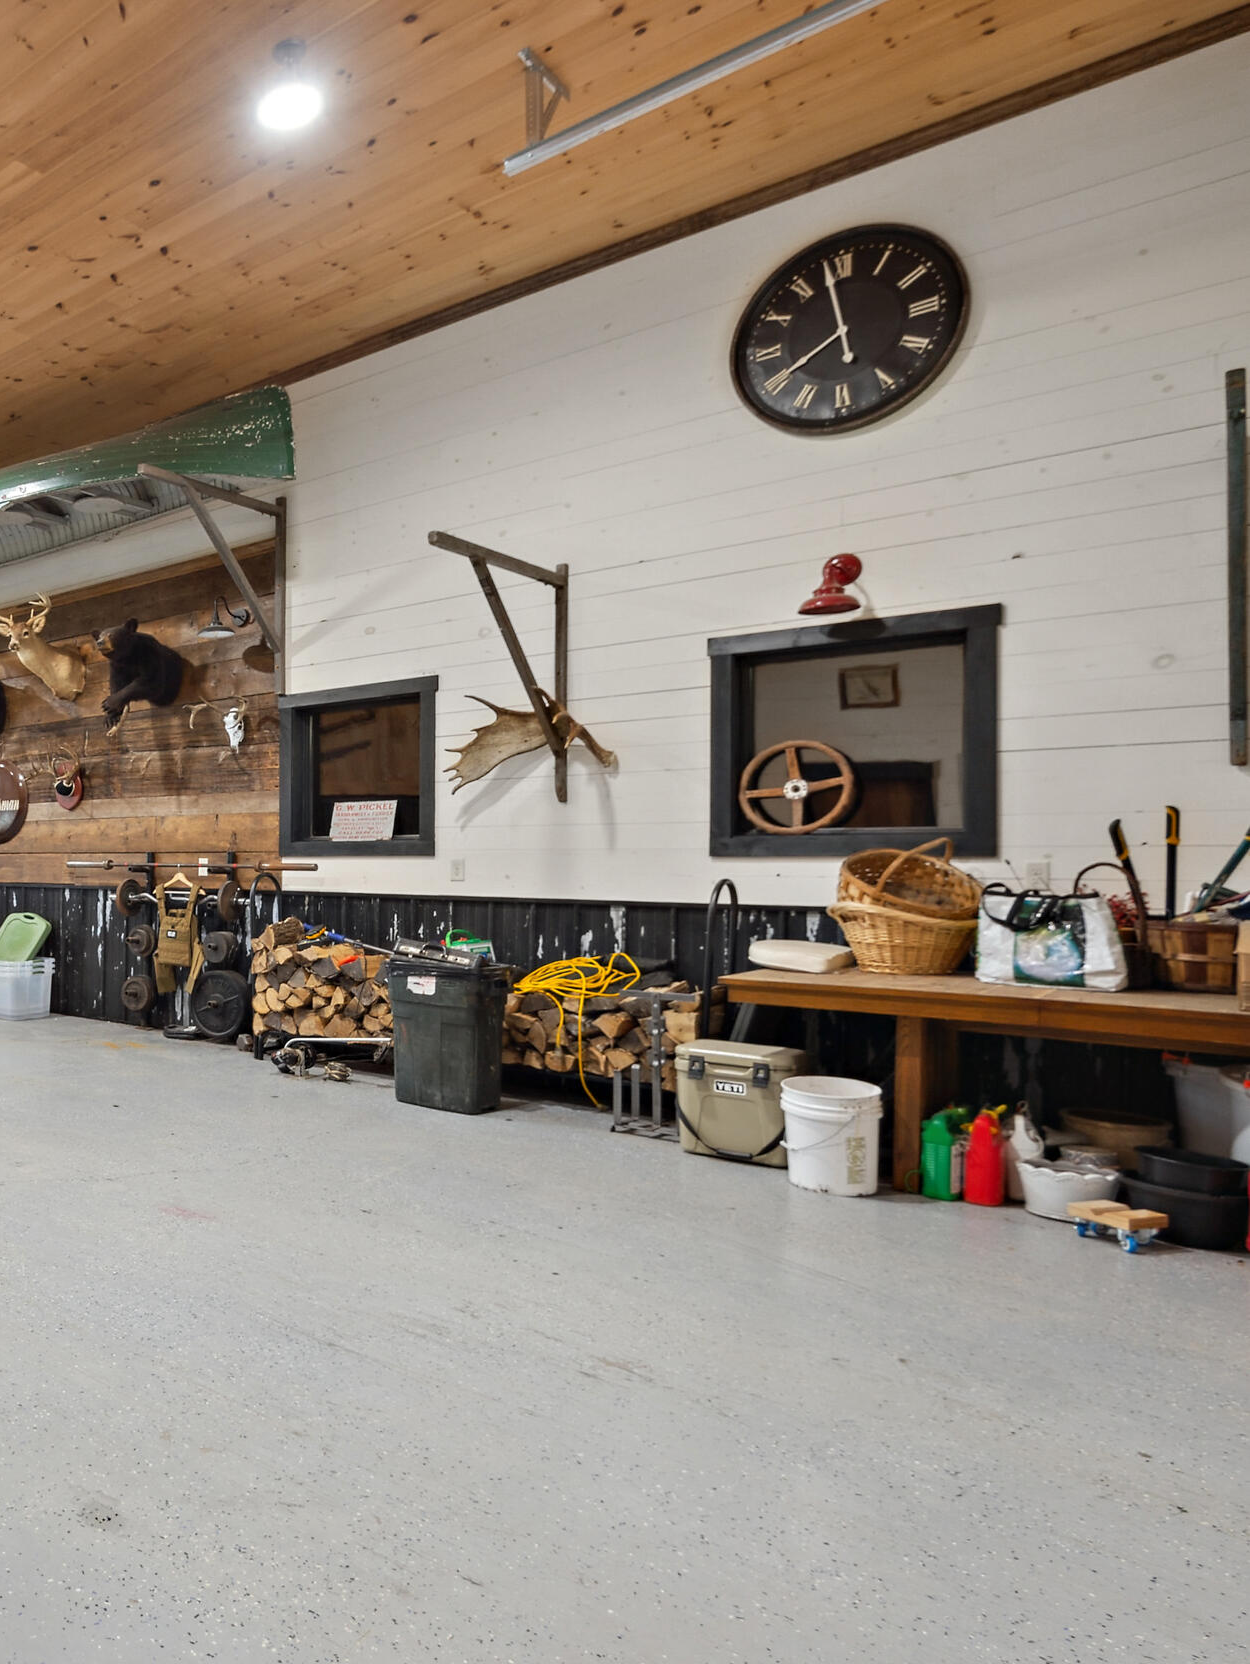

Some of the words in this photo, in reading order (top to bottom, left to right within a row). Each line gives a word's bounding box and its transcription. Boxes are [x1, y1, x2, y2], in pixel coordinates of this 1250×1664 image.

[834, 253, 853, 280] XII
[872, 250, 892, 276] I
[897, 264, 927, 290] II
[790, 278, 815, 303] XI
[908, 295, 940, 318] III
[765, 310, 792, 327] X
[755, 344, 782, 362] IX
[874, 367, 895, 389] V
[793, 384, 818, 408] VII
[834, 383, 851, 408] VI
[358, 802, 394, 810] PICKEL
[717, 1082, 743, 1092] YETI
